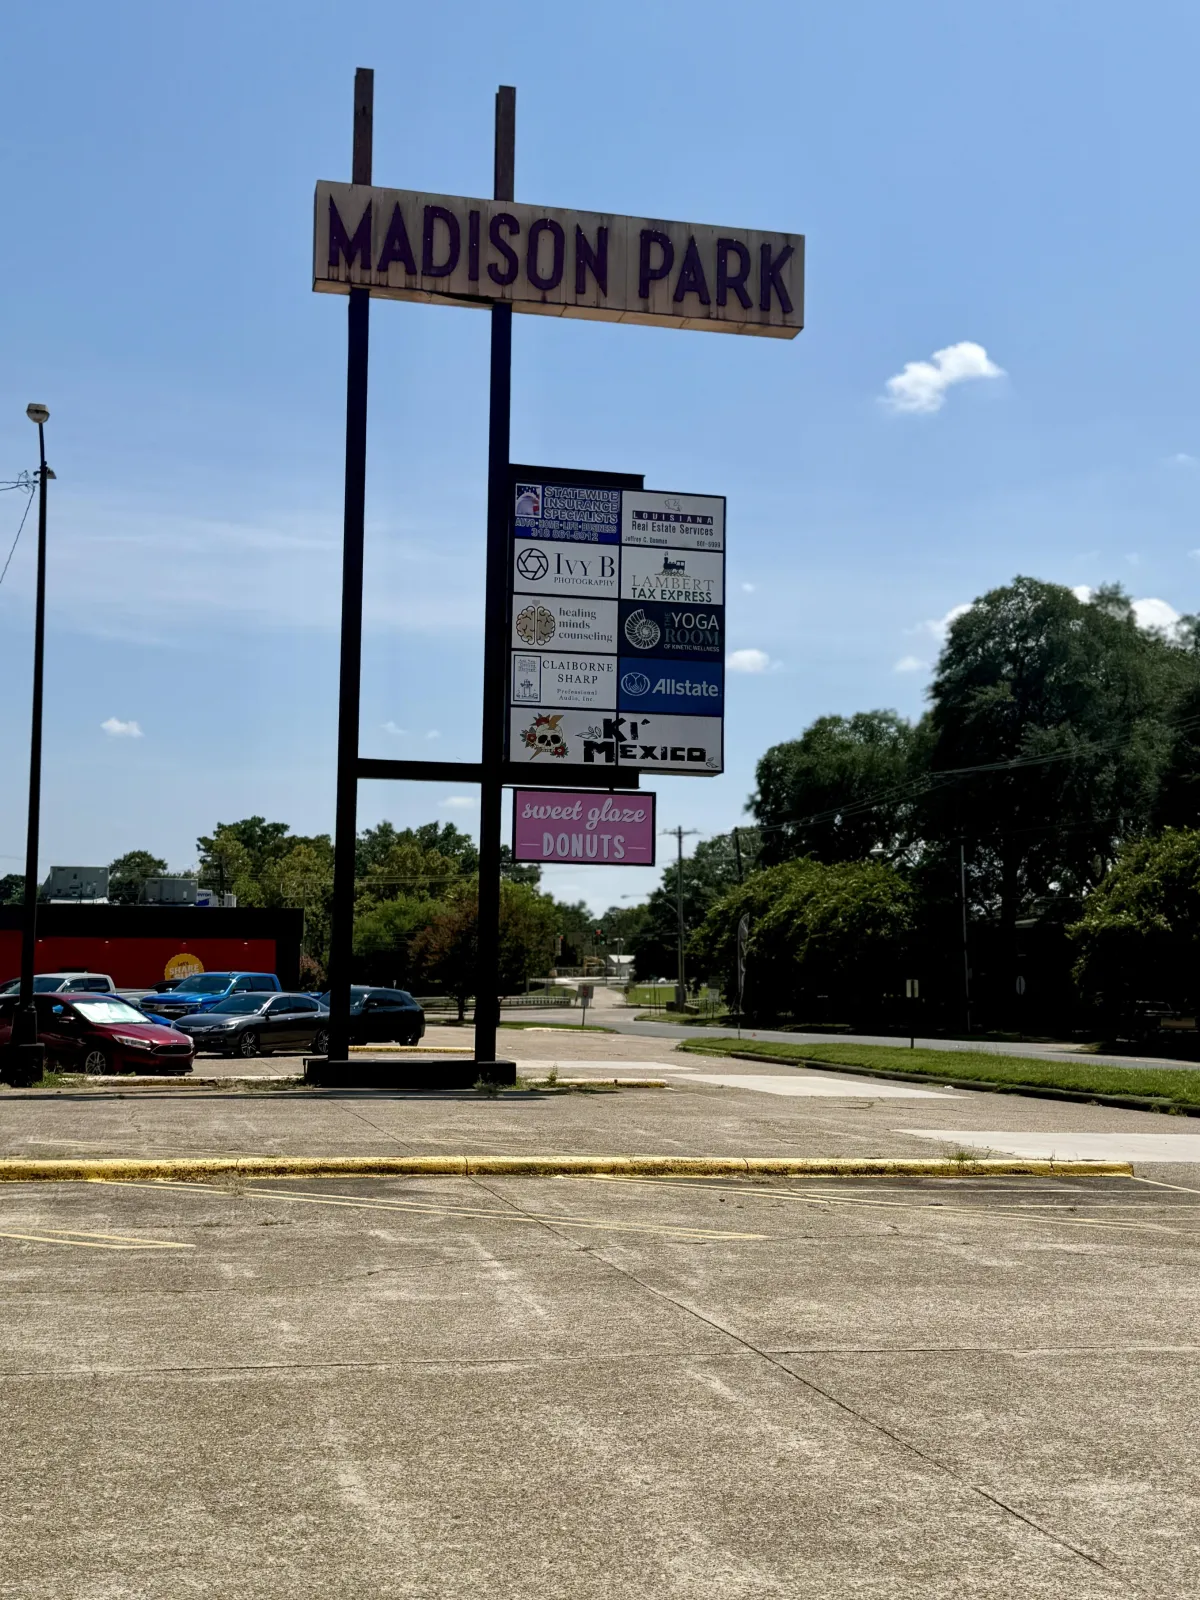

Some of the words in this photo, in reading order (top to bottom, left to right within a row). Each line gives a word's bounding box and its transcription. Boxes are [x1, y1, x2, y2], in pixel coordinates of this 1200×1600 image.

[328, 194, 608, 297] MADISON
[638, 229, 794, 314] PARK
[544, 486, 619, 502] STATEWIDE
[544, 498, 619, 513] INSURANCE
[544, 508, 618, 523] SPECIALISTS
[632, 511, 713, 525] LOUISIANA
[631, 521, 649, 532] Real
[652, 523, 676, 534] Estate
[679, 524, 714, 537] Services
[598, 555, 615, 578] B
[554, 576, 615, 587] PHOTOGRAPHY
[632, 575, 714, 592] LAMBERT
[632, 587, 656, 600] TAX
[660, 589, 712, 603] EXPRESS
[558, 607, 597, 621] healing
[671, 612, 720, 631] YOGA
[558, 619, 591, 630] minds
[558, 630, 613, 643] counseling
[664, 628, 719, 645] ROOM
[542, 660, 614, 672] CLAIBORNE
[557, 673, 598, 684] SHARP
[652, 678, 719, 697] Allstate
[521, 800, 583, 821] sweet
[585, 798, 647, 831] glaze
[542, 832, 625, 859] DONUTS
[169, 964, 200, 975] SHARE
